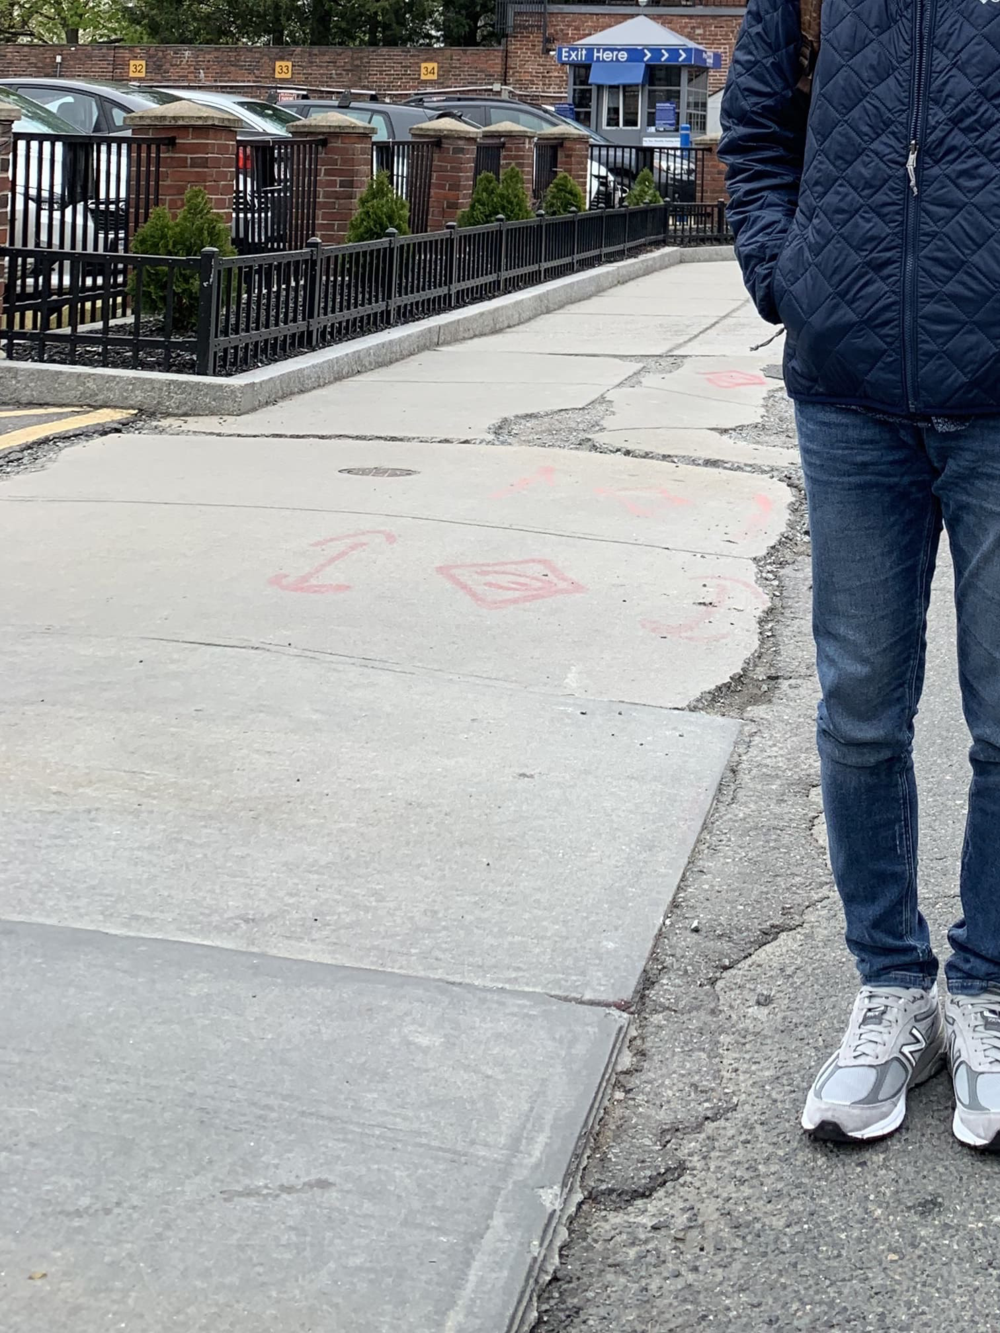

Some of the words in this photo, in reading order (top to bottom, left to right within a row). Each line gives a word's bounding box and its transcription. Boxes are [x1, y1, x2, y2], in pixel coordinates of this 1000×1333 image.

[561, 47, 587, 61] Exit
[593, 48, 628, 62] Here
[131, 63, 144, 74] 32
[277, 64, 290, 75] 33
[422, 66, 436, 76] 34
